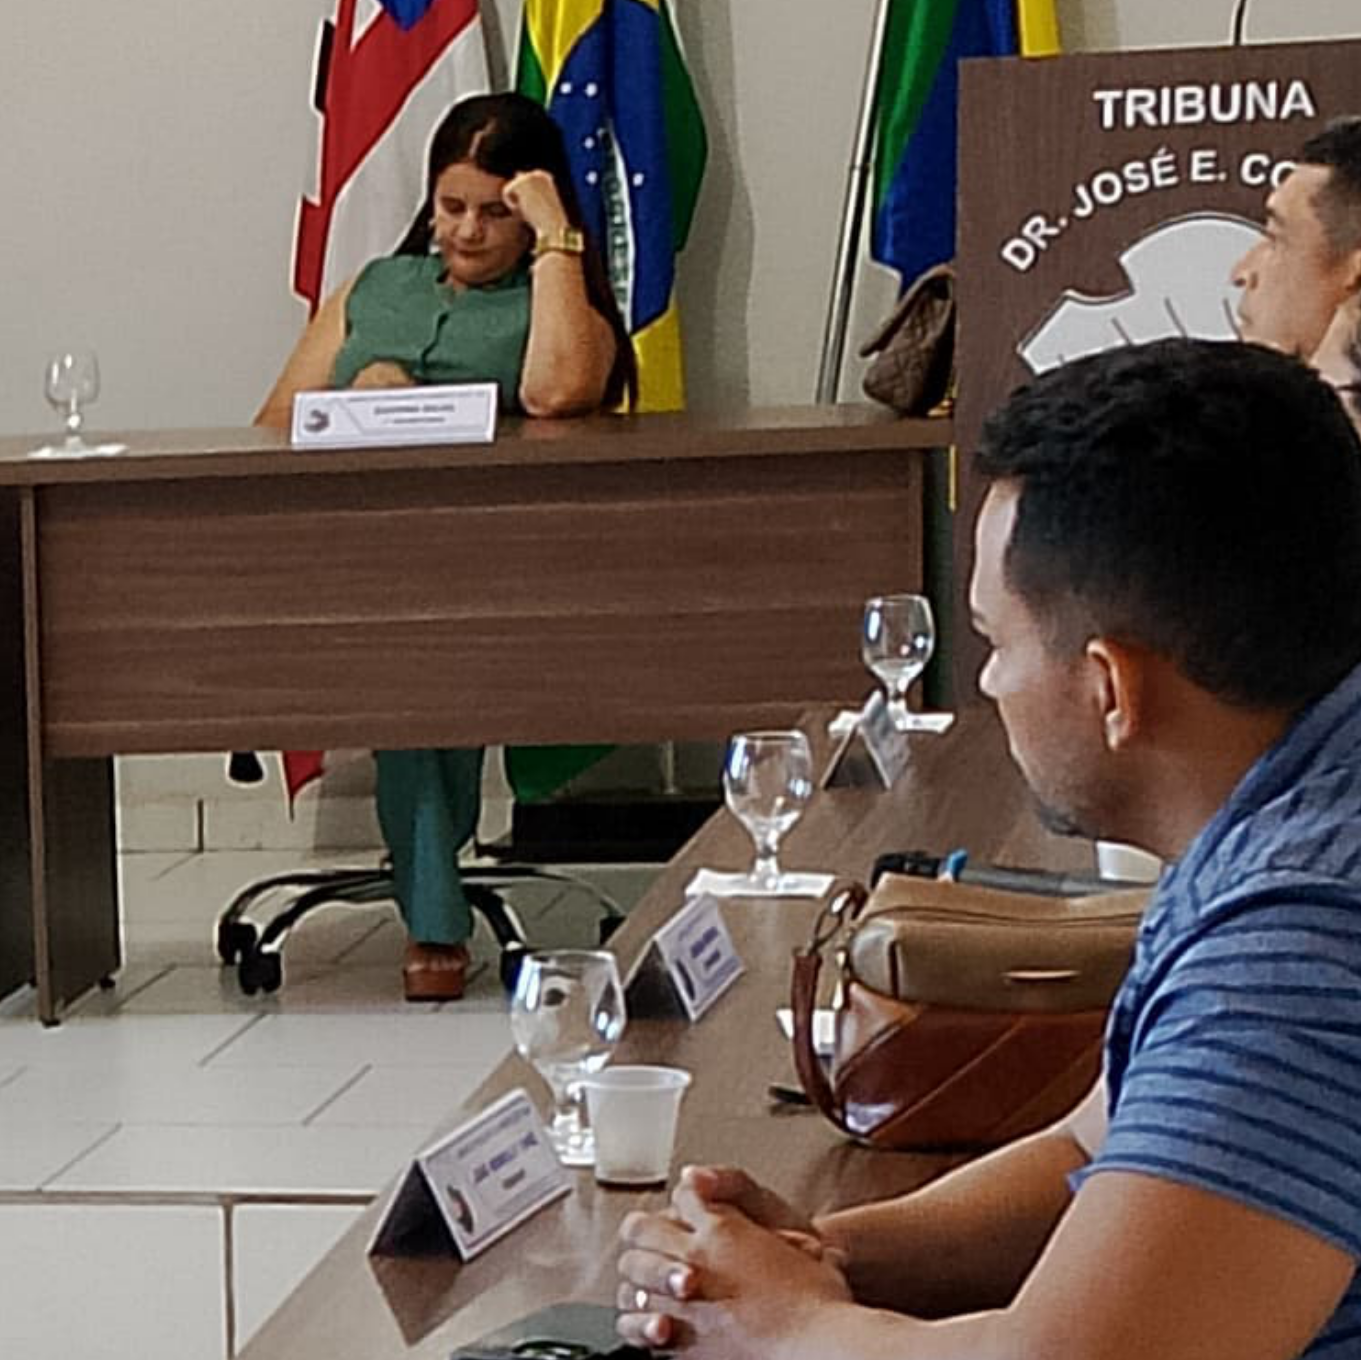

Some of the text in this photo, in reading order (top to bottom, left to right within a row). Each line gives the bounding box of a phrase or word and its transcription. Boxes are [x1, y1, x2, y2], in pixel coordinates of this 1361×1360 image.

[1092, 80, 1315, 129] TRIBUNA
[1001, 216, 1068, 271] DR.
[1072, 149, 1179, 218] JOSÉ
[1190, 150, 1227, 182] E.
